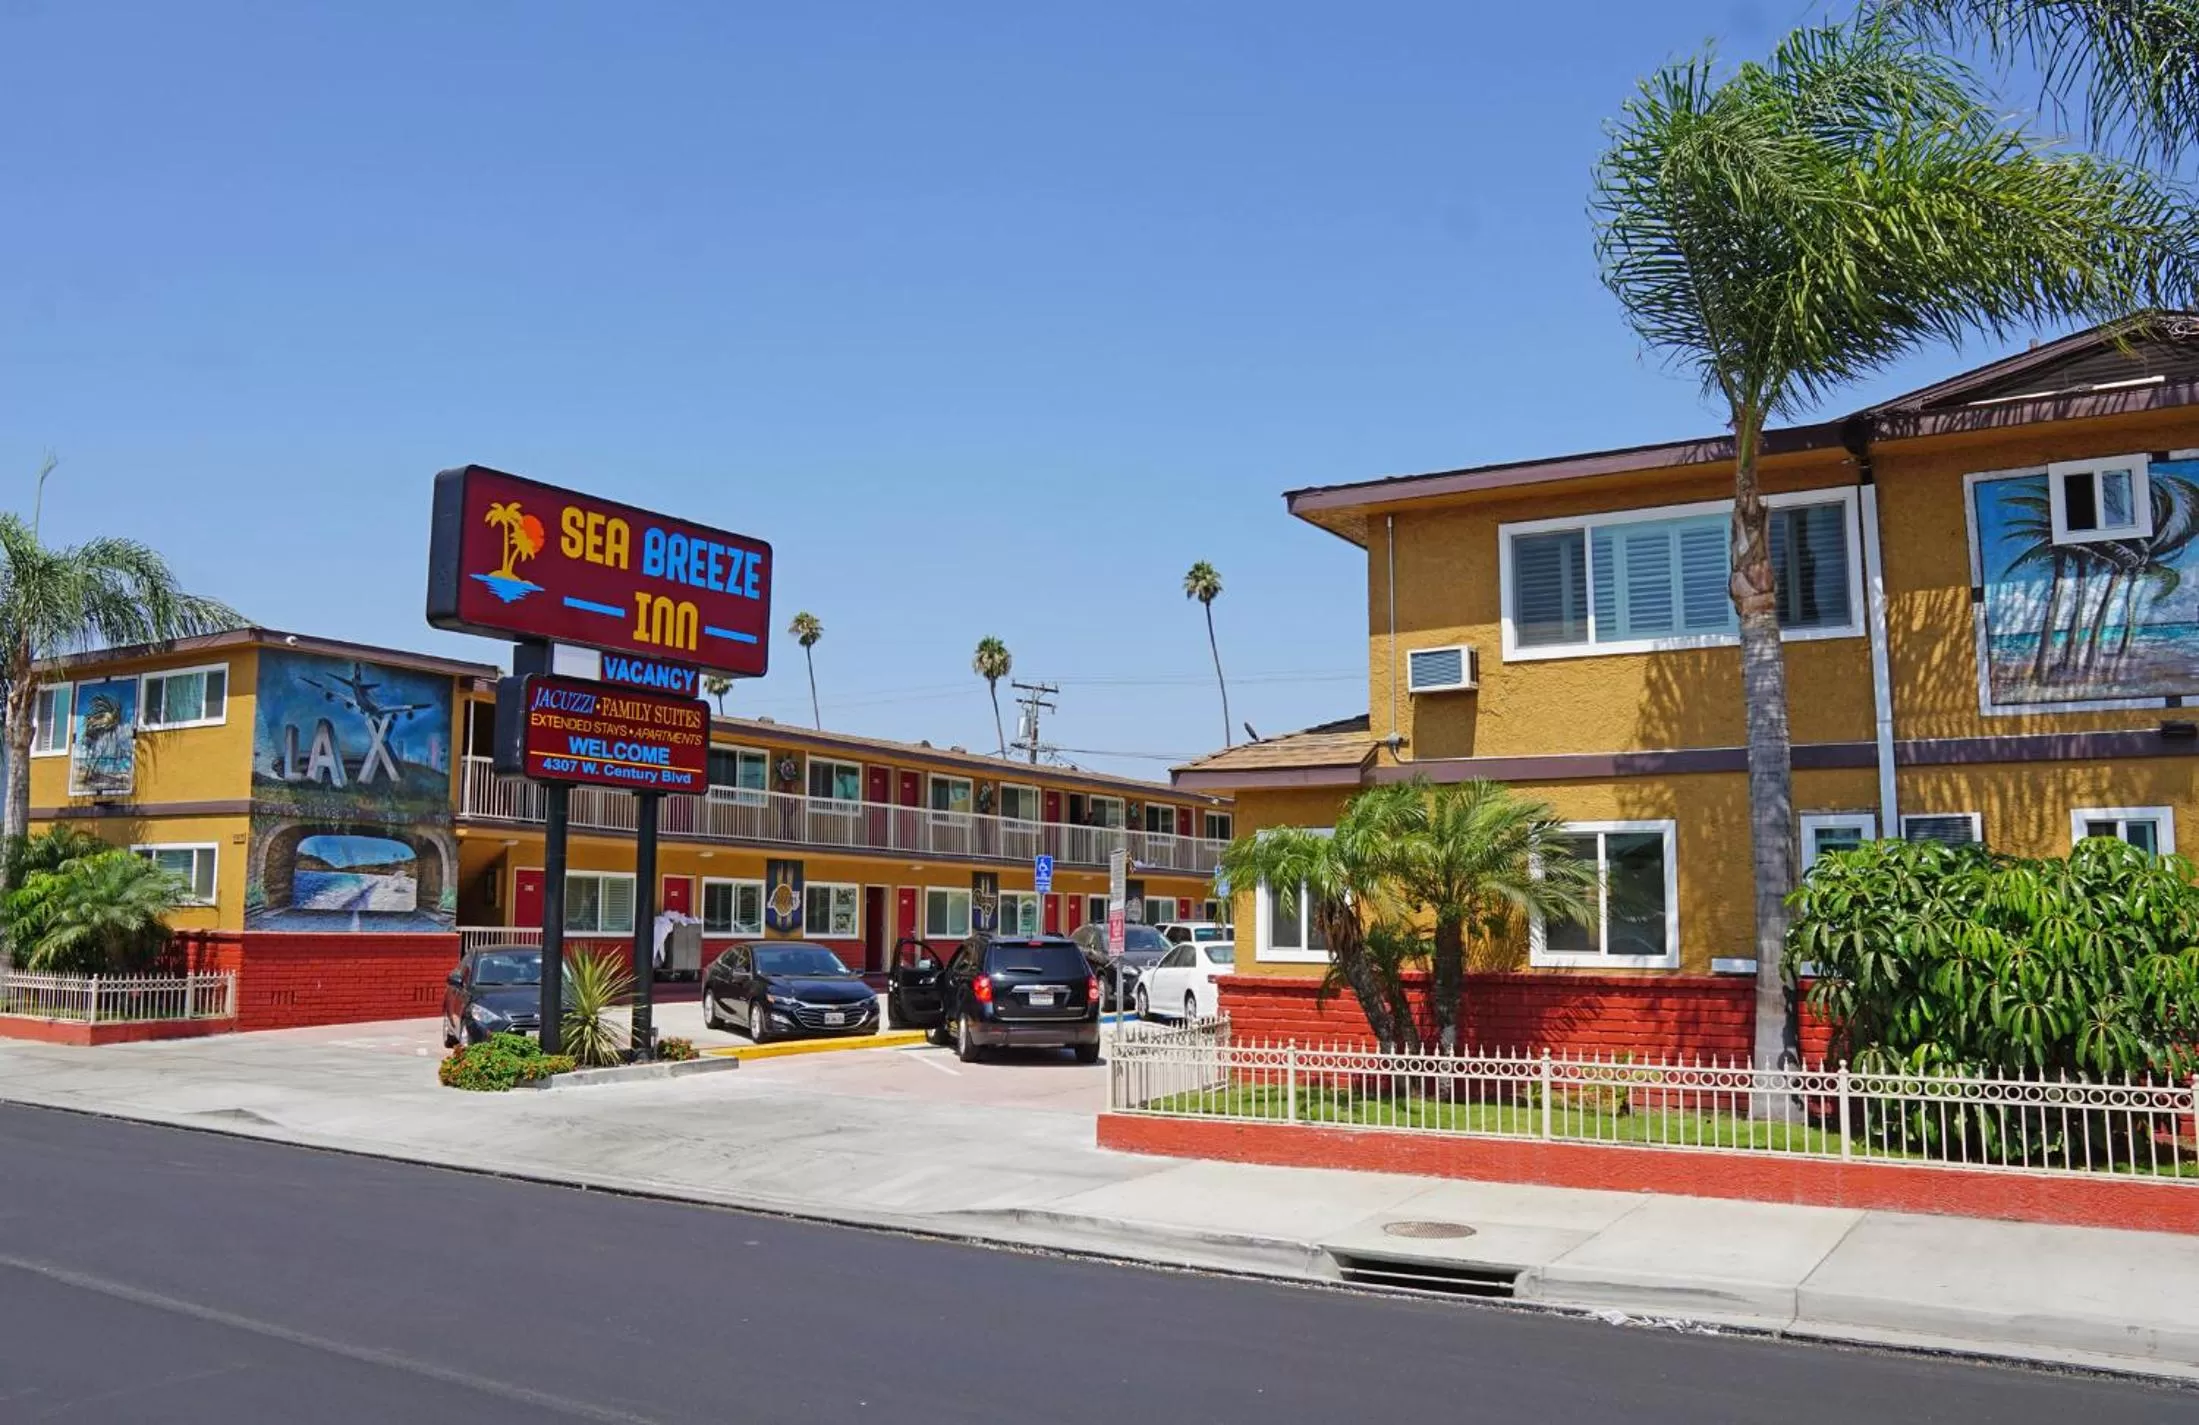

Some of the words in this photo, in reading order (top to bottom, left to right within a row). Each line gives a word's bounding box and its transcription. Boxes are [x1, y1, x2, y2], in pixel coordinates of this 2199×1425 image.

[561, 506, 630, 569] SEA
[643, 528, 762, 600] BREEZE
[633, 591, 699, 651] INN
[603, 656, 696, 691] VACANCY
[531, 687, 596, 714] JACUZZI
[601, 697, 651, 722] FAMILY
[654, 705, 701, 729] SUITES
[531, 714, 591, 732] EXTENDED
[593, 721, 628, 737] STAYS
[634, 727, 703, 746] APARTMENTS
[569, 736, 670, 765] WELCOME
[543, 757, 577, 773] 4307
[582, 762, 599, 775] W.
[603, 764, 658, 783] Century
[661, 770, 692, 784] Blvd
